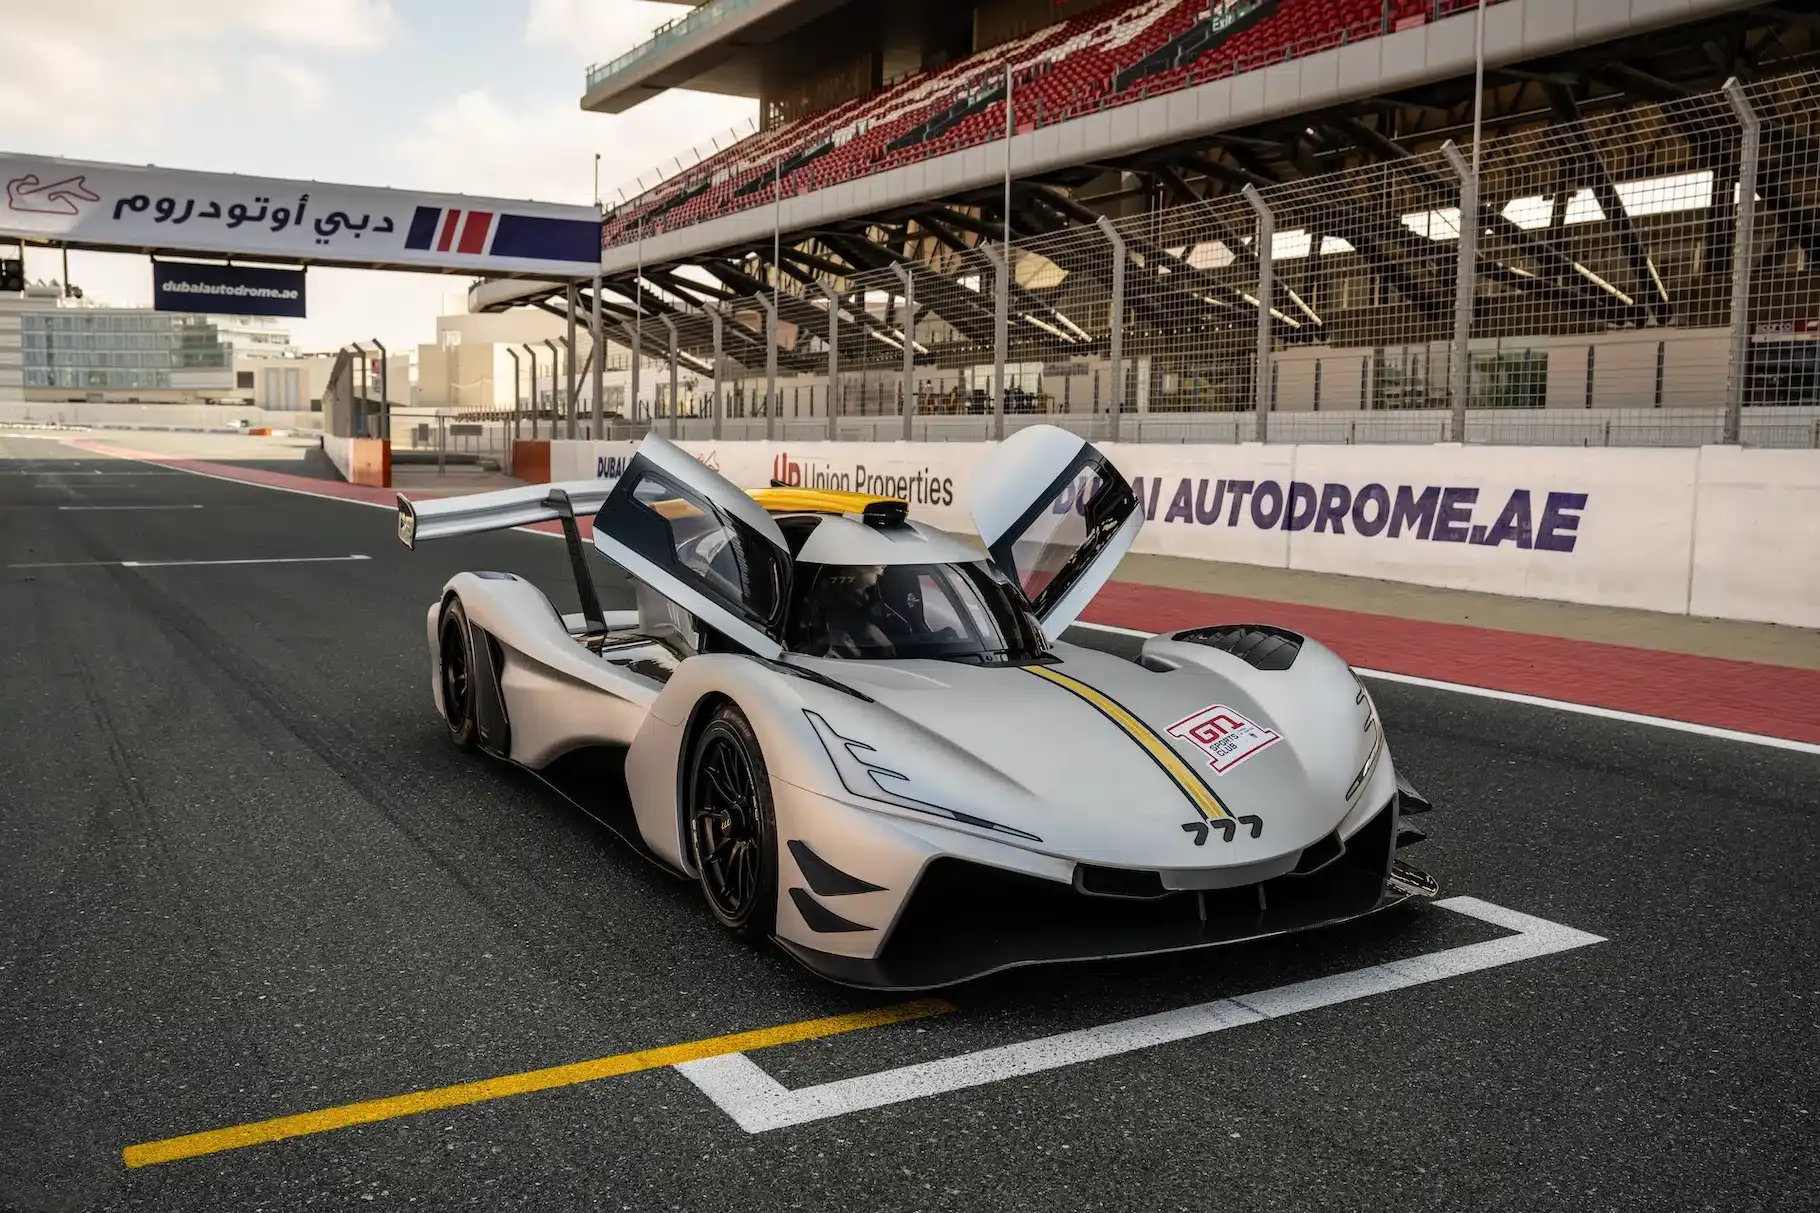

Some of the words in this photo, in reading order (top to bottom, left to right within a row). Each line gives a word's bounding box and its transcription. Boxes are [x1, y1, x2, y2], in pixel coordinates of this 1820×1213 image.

[112, 193, 309, 232] أوتودروم
[314, 211, 395, 245] دبي
[162, 280, 299, 299] dubaiautodrome.ae
[804, 462, 850, 492] Union
[856, 465, 953, 507] Properties
[1164, 477, 1589, 553] AUTODROME.AE
[1209, 733, 1239, 752] SPORTS
[1216, 744, 1238, 757] CLUB
[1181, 814, 1264, 847] 777
